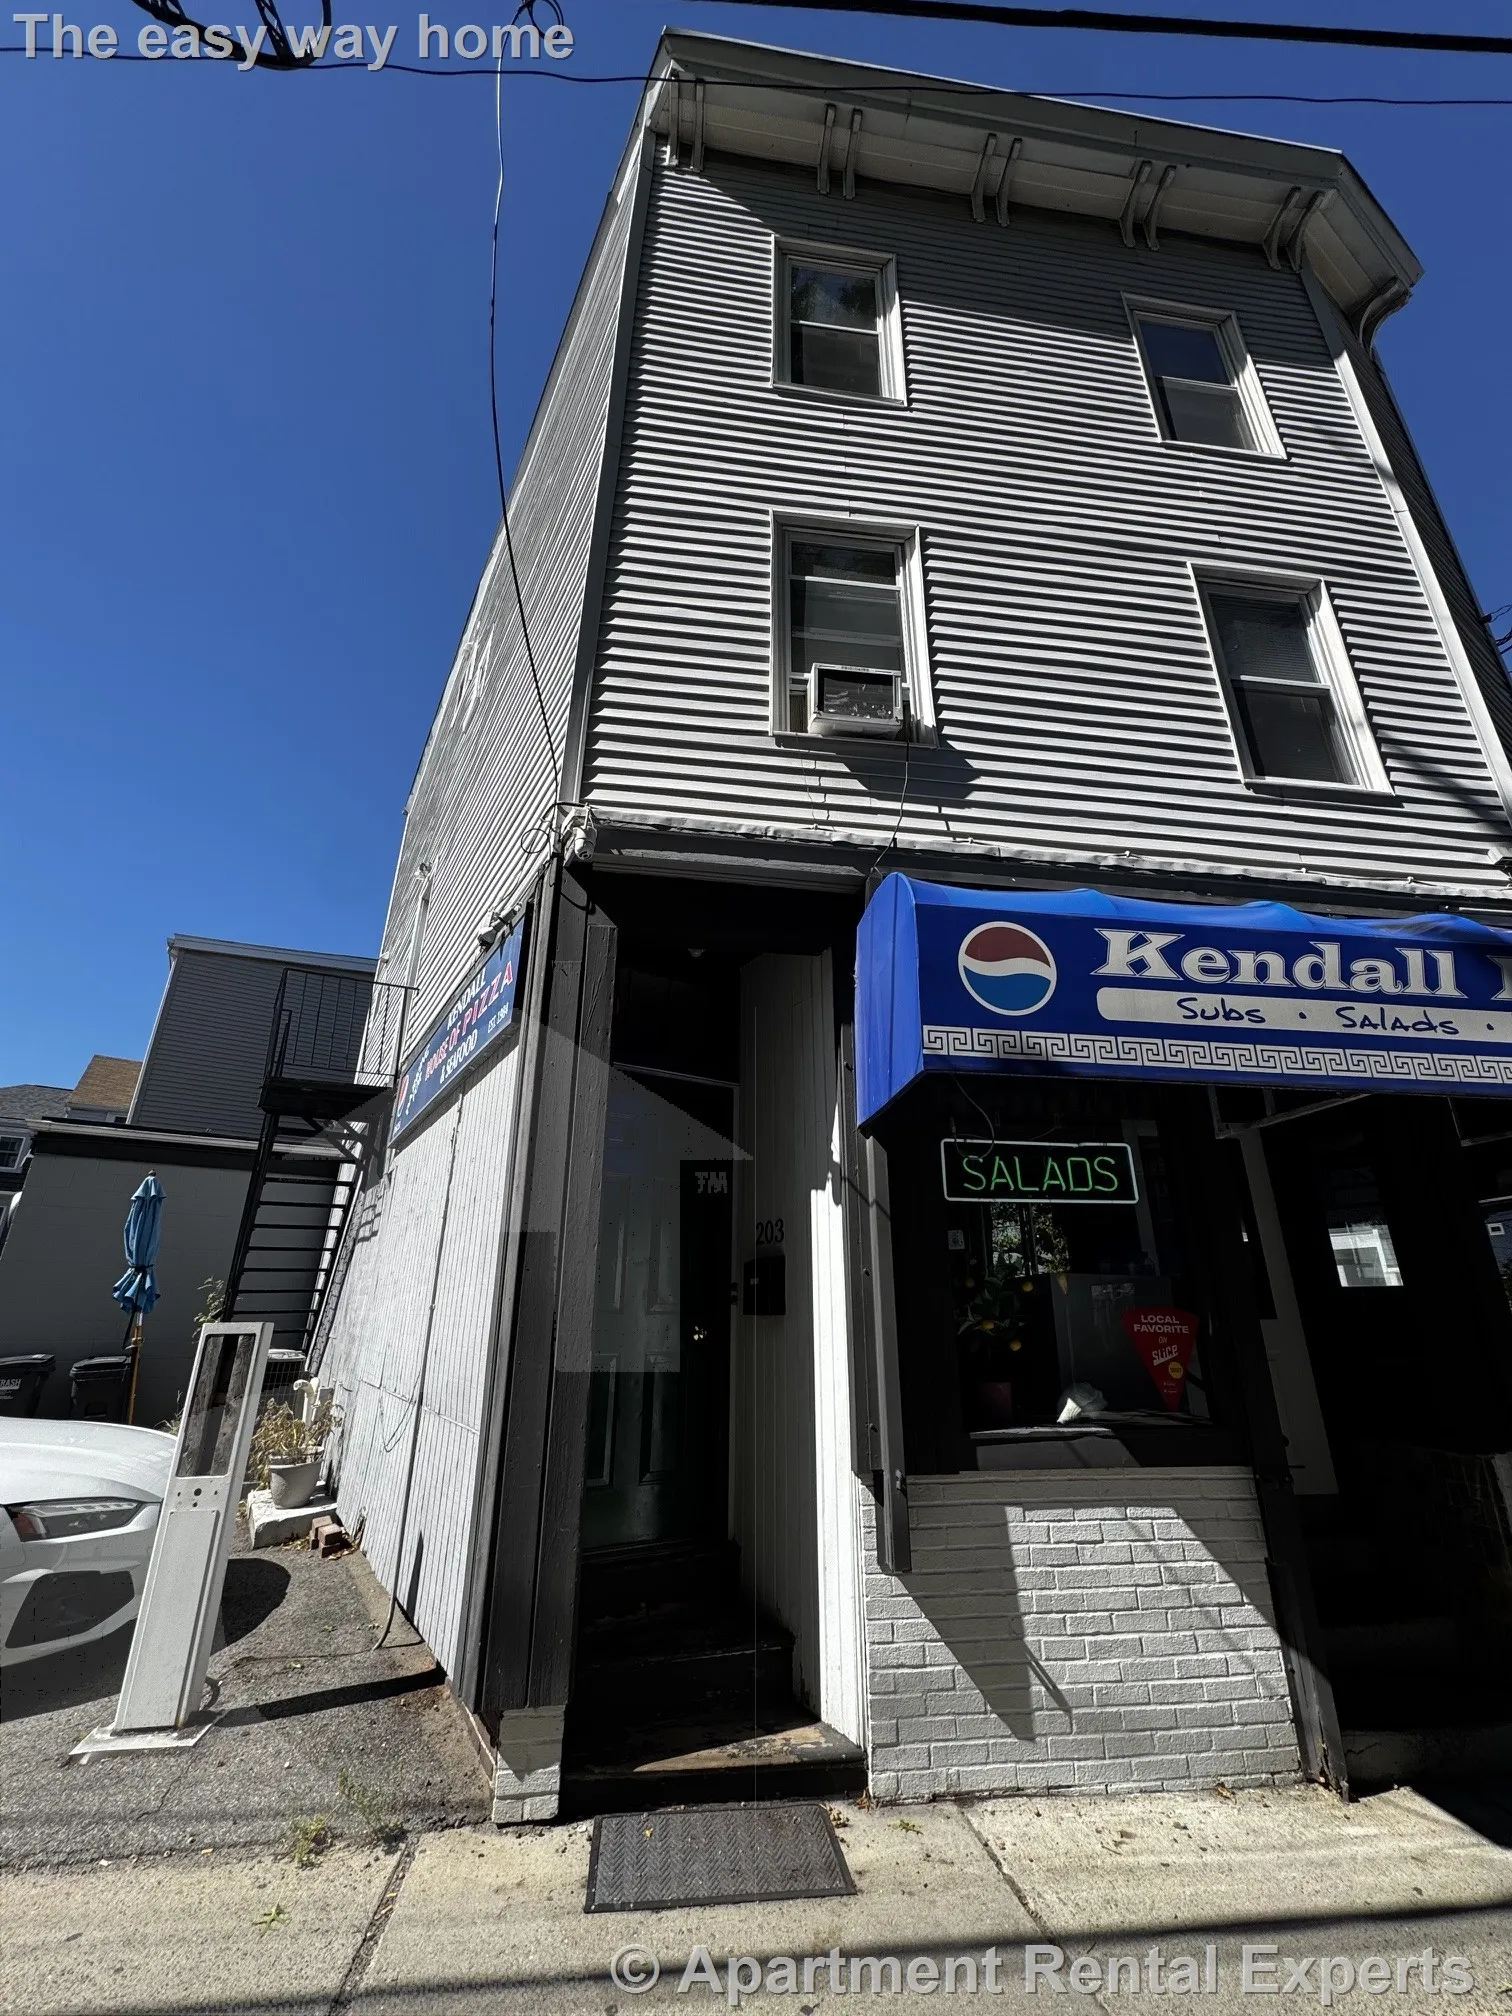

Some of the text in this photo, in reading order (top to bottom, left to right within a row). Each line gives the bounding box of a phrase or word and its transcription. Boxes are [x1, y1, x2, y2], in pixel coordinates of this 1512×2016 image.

[1089, 927, 1469, 998] Kendall
[425, 960, 513, 1081] HOUSE OF PIZZA
[1176, 997, 1267, 1024] Subs
[445, 1028, 478, 1079] SEAFOOD
[962, 1155, 1119, 1192] SALADS
[755, 1218, 785, 1245] 203
[1133, 1323, 1190, 1334] FAVORITE
[1140, 1314, 1180, 1324] LOCAL
[1158, 1336, 1168, 1344] ON
[0, 1378, 22, 1389] RASH
